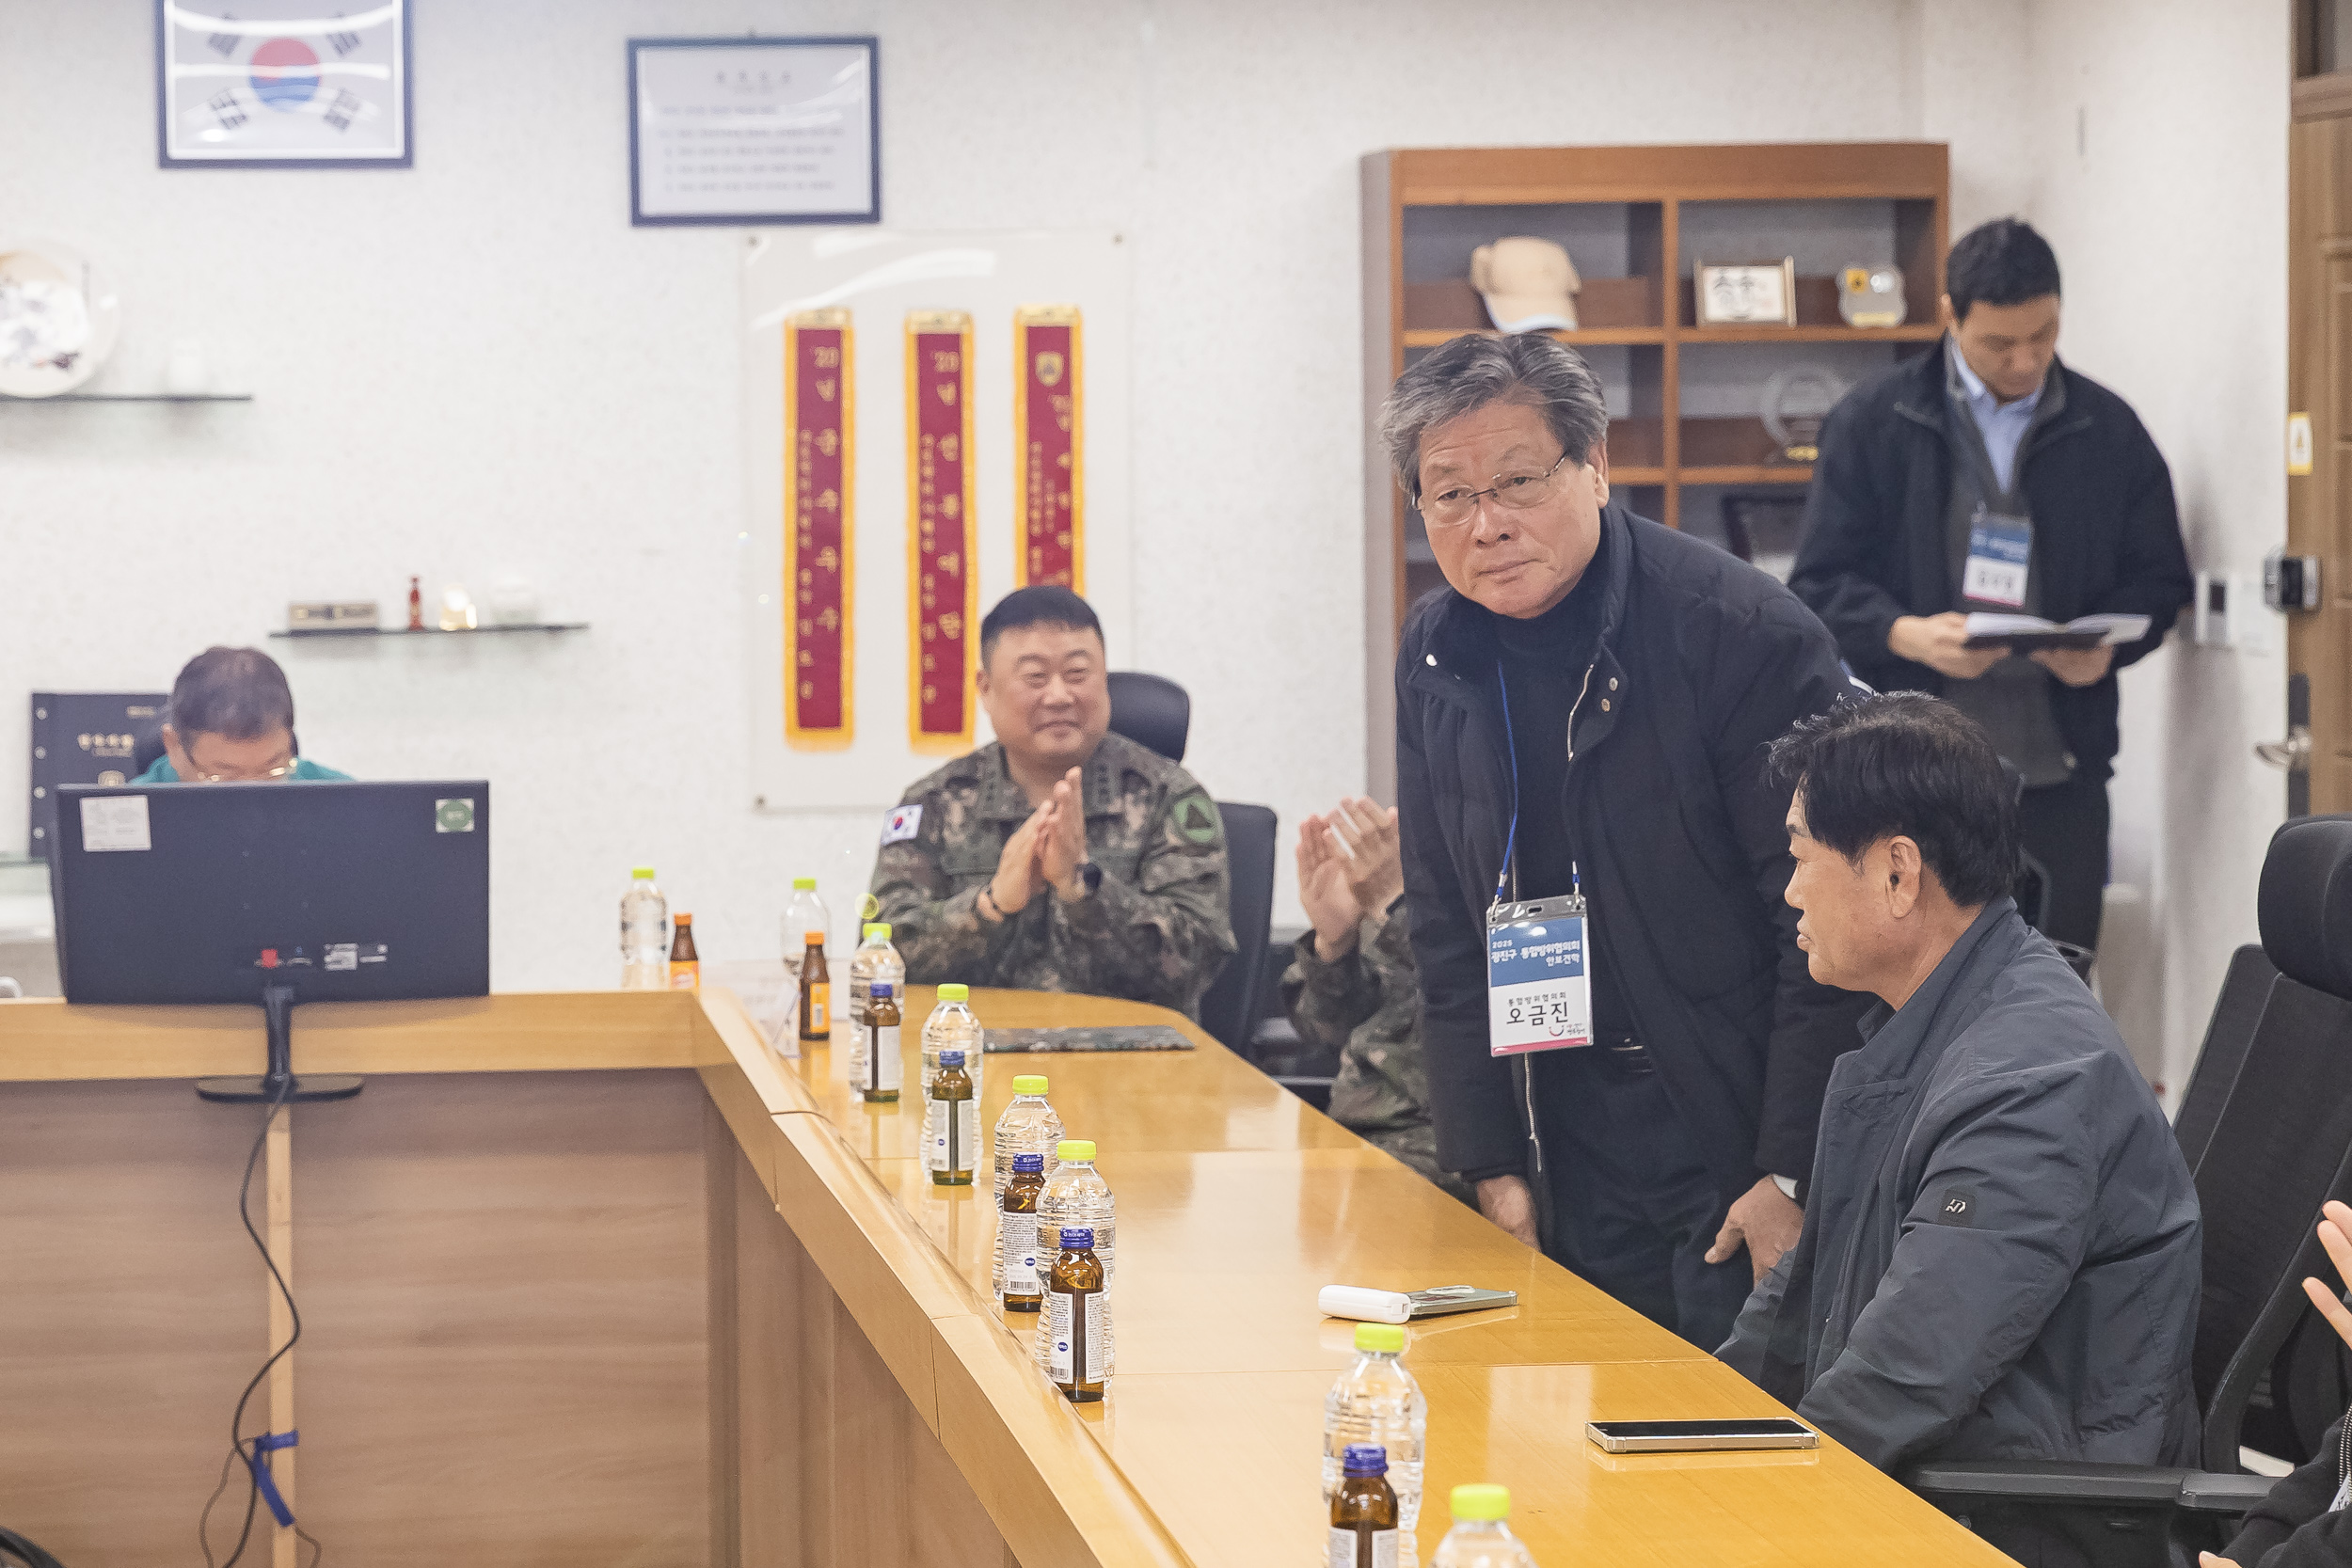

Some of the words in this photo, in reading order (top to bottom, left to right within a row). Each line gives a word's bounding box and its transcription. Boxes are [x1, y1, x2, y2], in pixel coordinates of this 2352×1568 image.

[1491, 949, 1518, 963] 광진구
[1520, 941, 1581, 959] 통합방위협의회
[1492, 940, 1513, 948] 2025
[1506, 1001, 1568, 1026] 오금진
